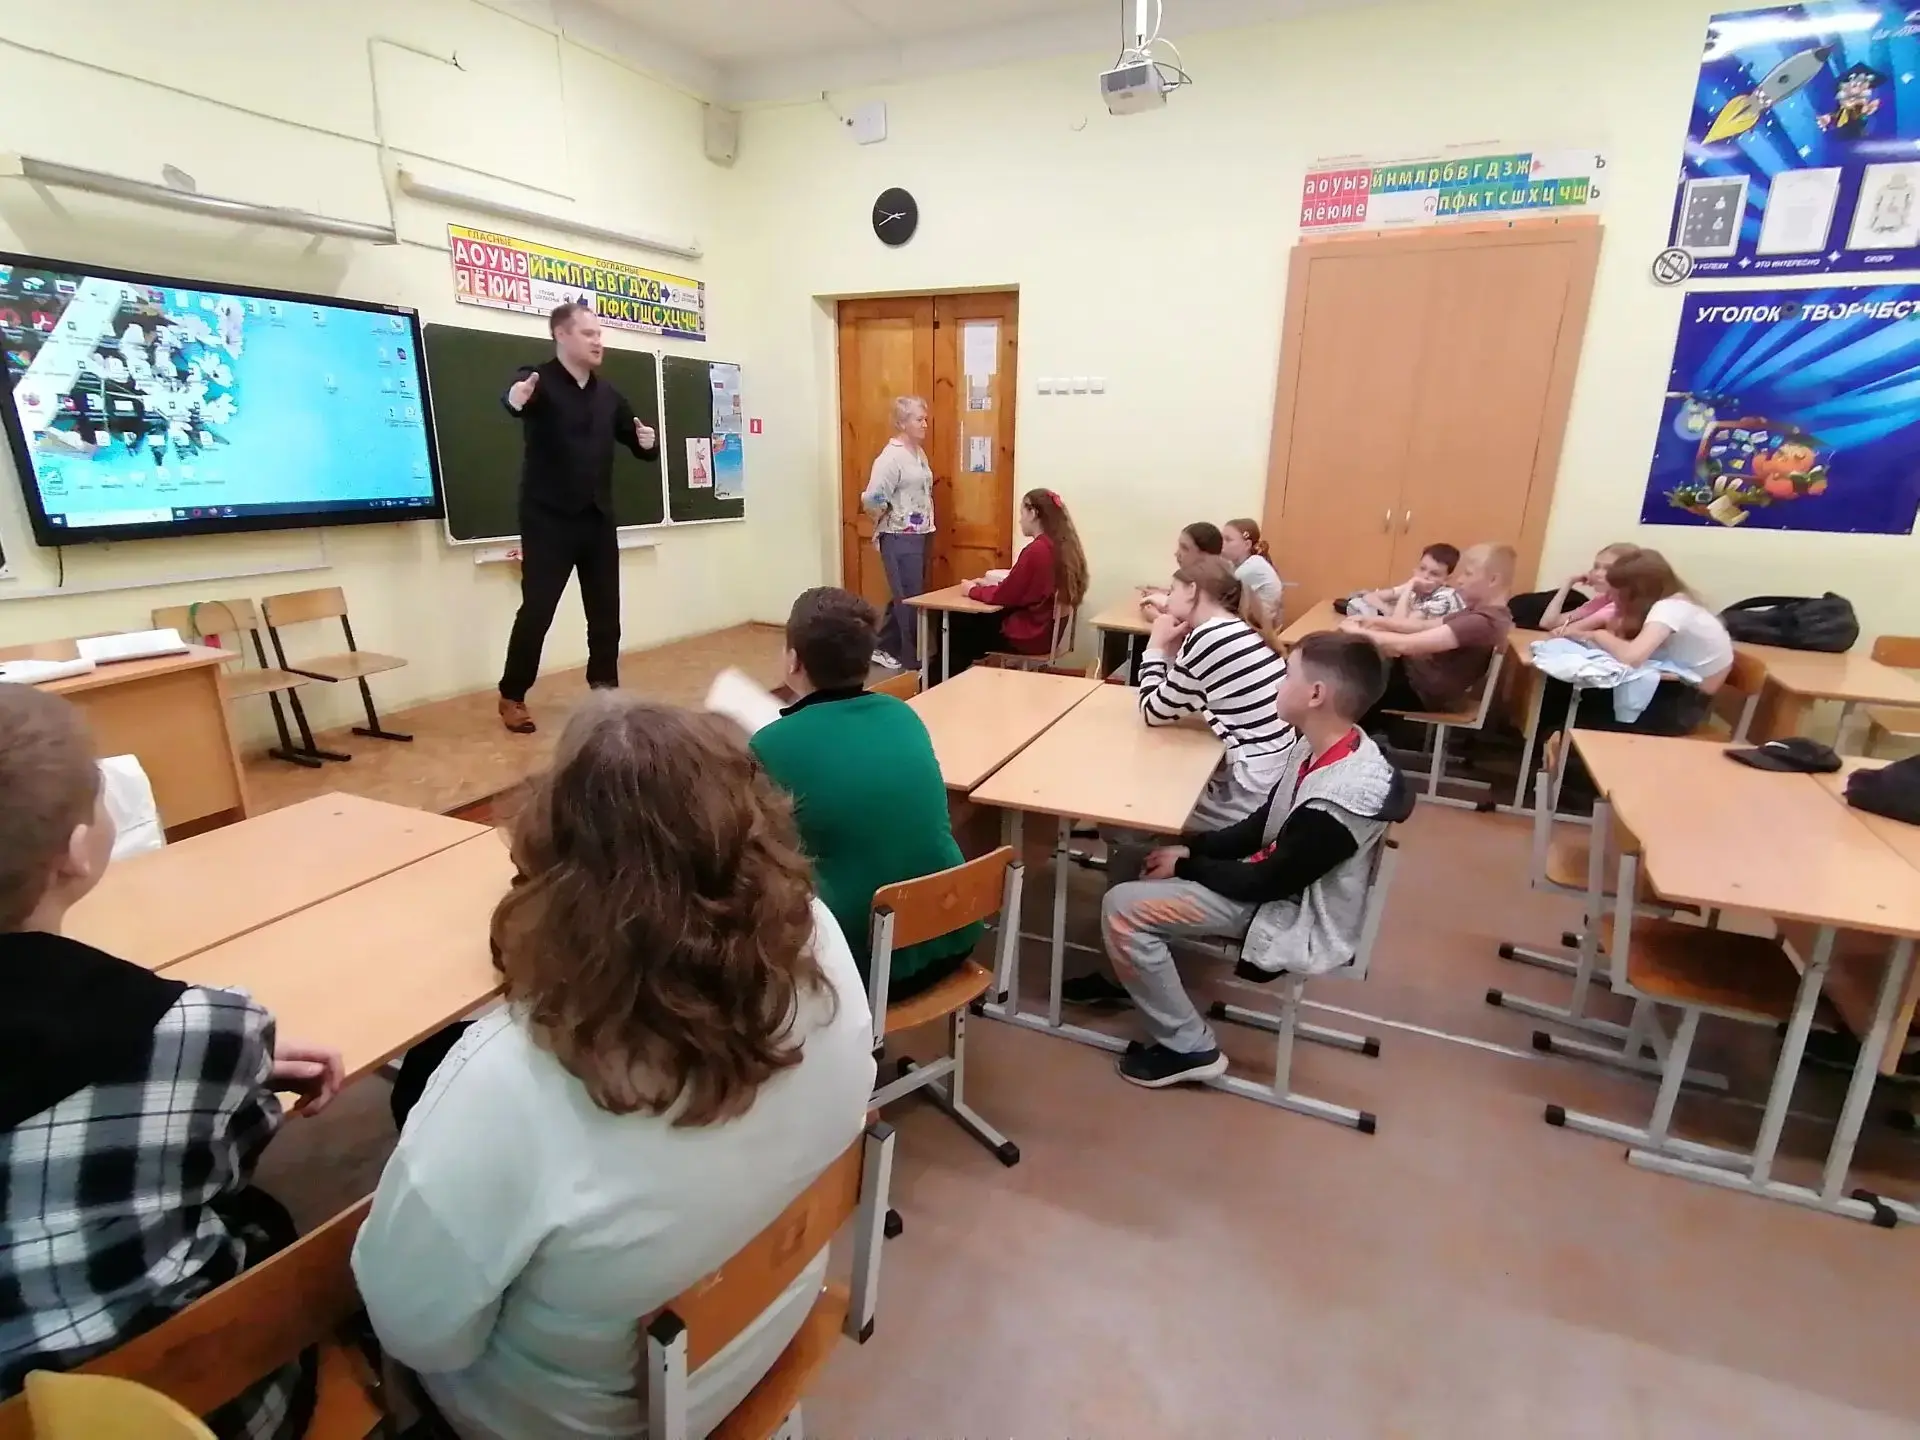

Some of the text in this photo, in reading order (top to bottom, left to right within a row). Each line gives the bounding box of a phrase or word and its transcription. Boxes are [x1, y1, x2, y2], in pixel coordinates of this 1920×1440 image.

[468, 230, 512, 246] ГЛАСНЫЕ
[595, 260, 639, 274] СОГЛАСНЫЕ
[1771, 258, 1821, 268] ИНТЕРЕСНО
[1696, 304, 1782, 323] УГОЛОК
